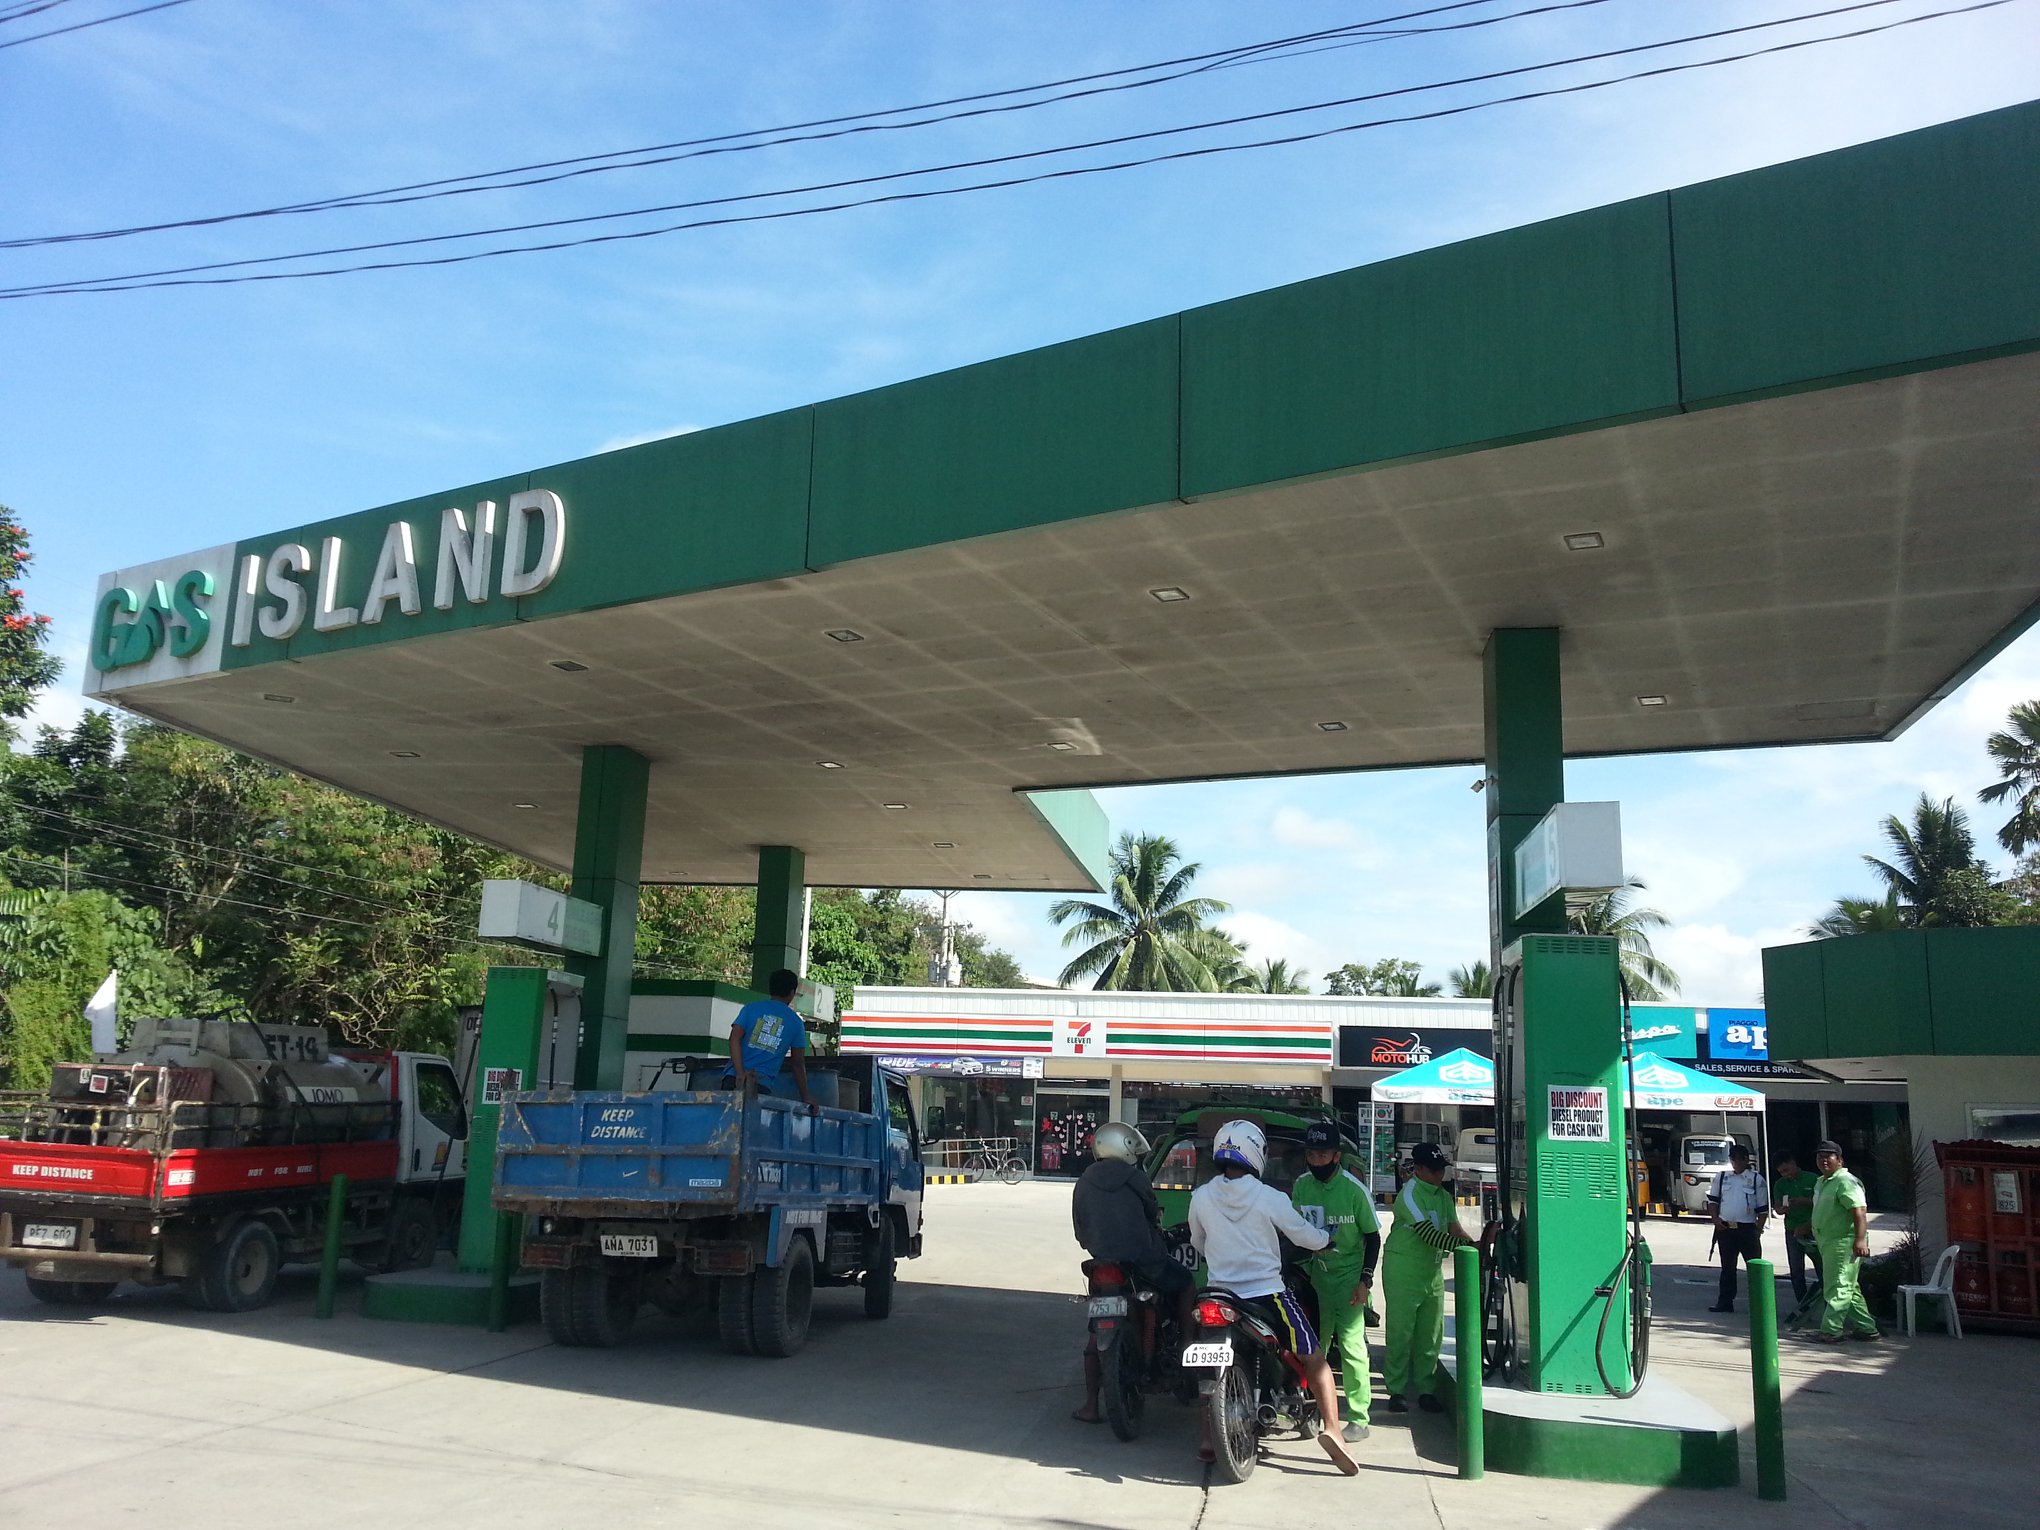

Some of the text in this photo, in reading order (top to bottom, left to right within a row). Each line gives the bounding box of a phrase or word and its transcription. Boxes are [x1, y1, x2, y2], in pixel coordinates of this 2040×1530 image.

[91, 487, 566, 673] GAS ISLAND
[547, 901, 559, 937] 4
[816, 988, 823, 1014] 2
[1371, 1053, 1430, 1064] MOTOHUB
[1763, 1065, 1771, 1073] &
[1772, 1065, 1801, 1074] SPAR
[1551, 1091, 1602, 1108] BIG DISCOUNT
[1647, 1096, 1684, 1107] ape
[601, 1109, 634, 1122] KEEP
[1552, 1109, 1603, 1123] DIESEL PRODUCT
[591, 1126, 648, 1139] DISTANCE
[1552, 1123, 1604, 1137] FOR CASH ONLY
[12, 1164, 94, 1180] KEEP DISTANCE
[248, 1168, 264, 1177] NOT
[1326, 1215, 1355, 1225] ISLAND
[604, 1238, 654, 1252] ANA 7031
[1185, 1352, 1230, 1364] LD 93953
